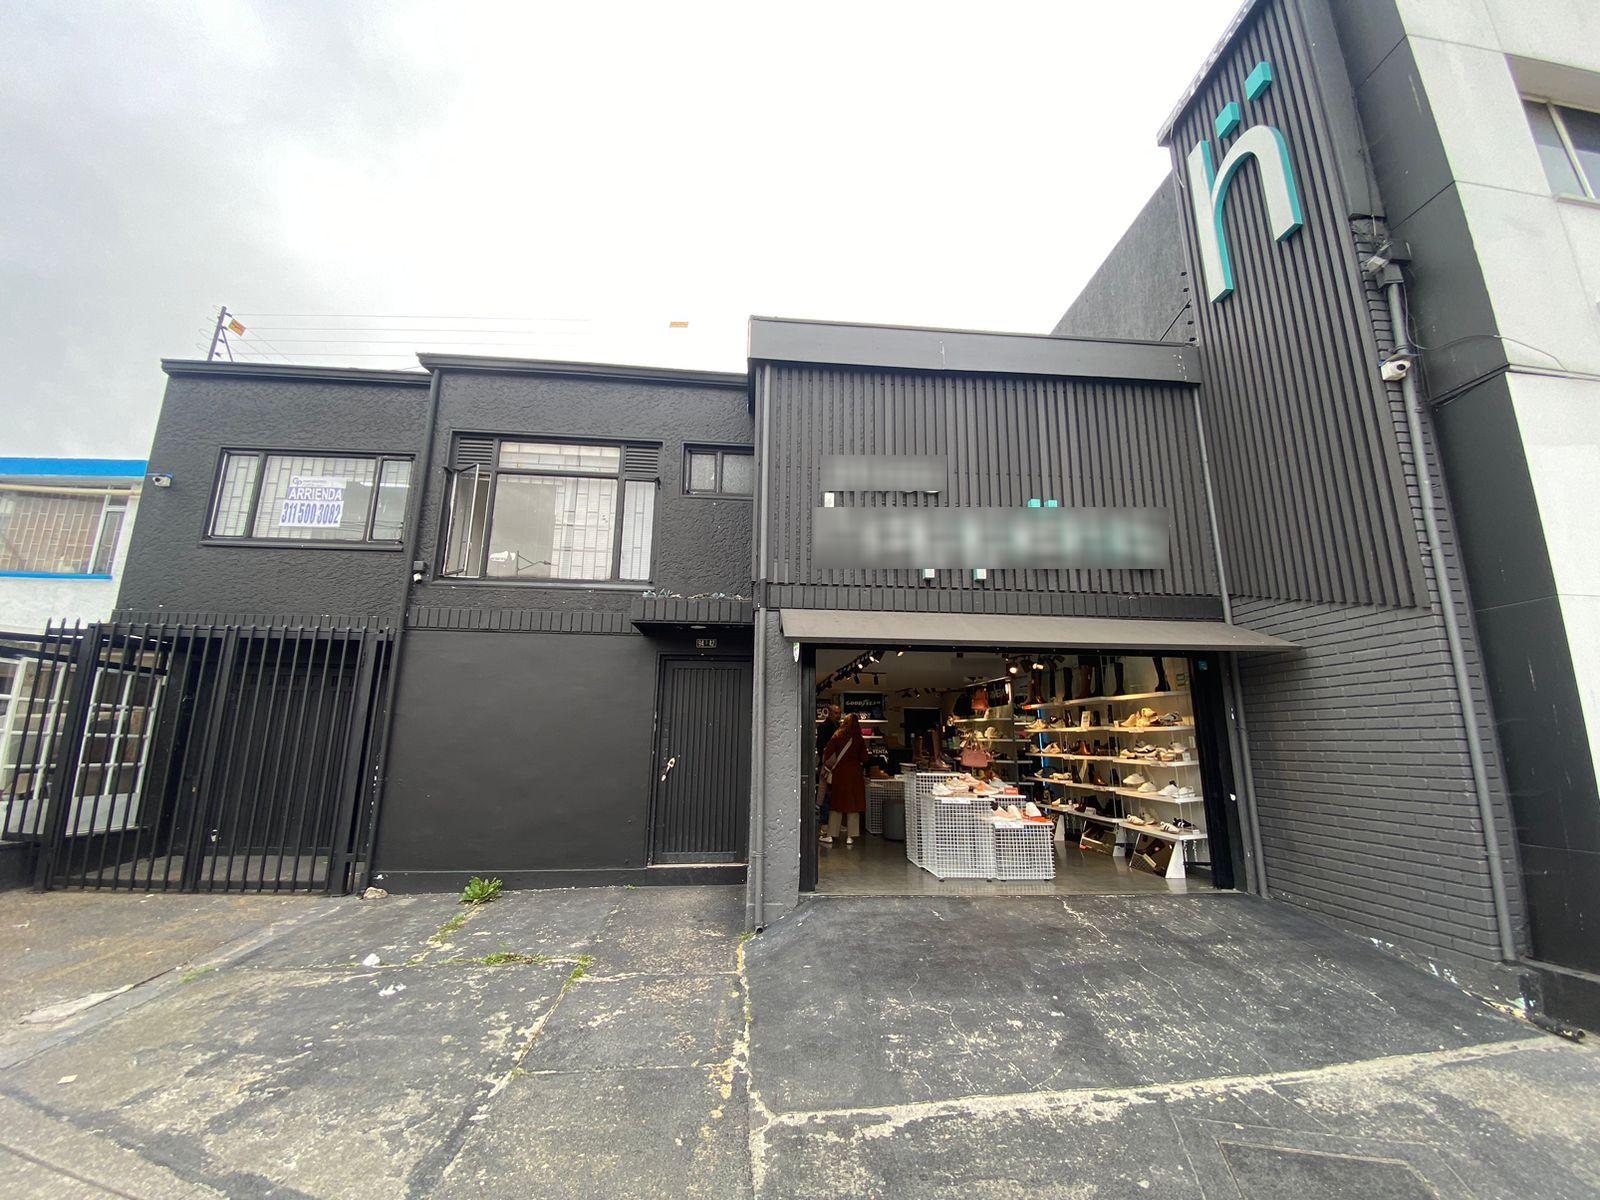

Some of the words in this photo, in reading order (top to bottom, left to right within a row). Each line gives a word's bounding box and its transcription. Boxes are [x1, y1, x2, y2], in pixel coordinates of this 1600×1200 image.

[288, 487, 342, 501] ARRIENDA
[281, 502, 298, 523] 311
[298, 503, 317, 524] 500
[317, 504, 341, 525] 3082
